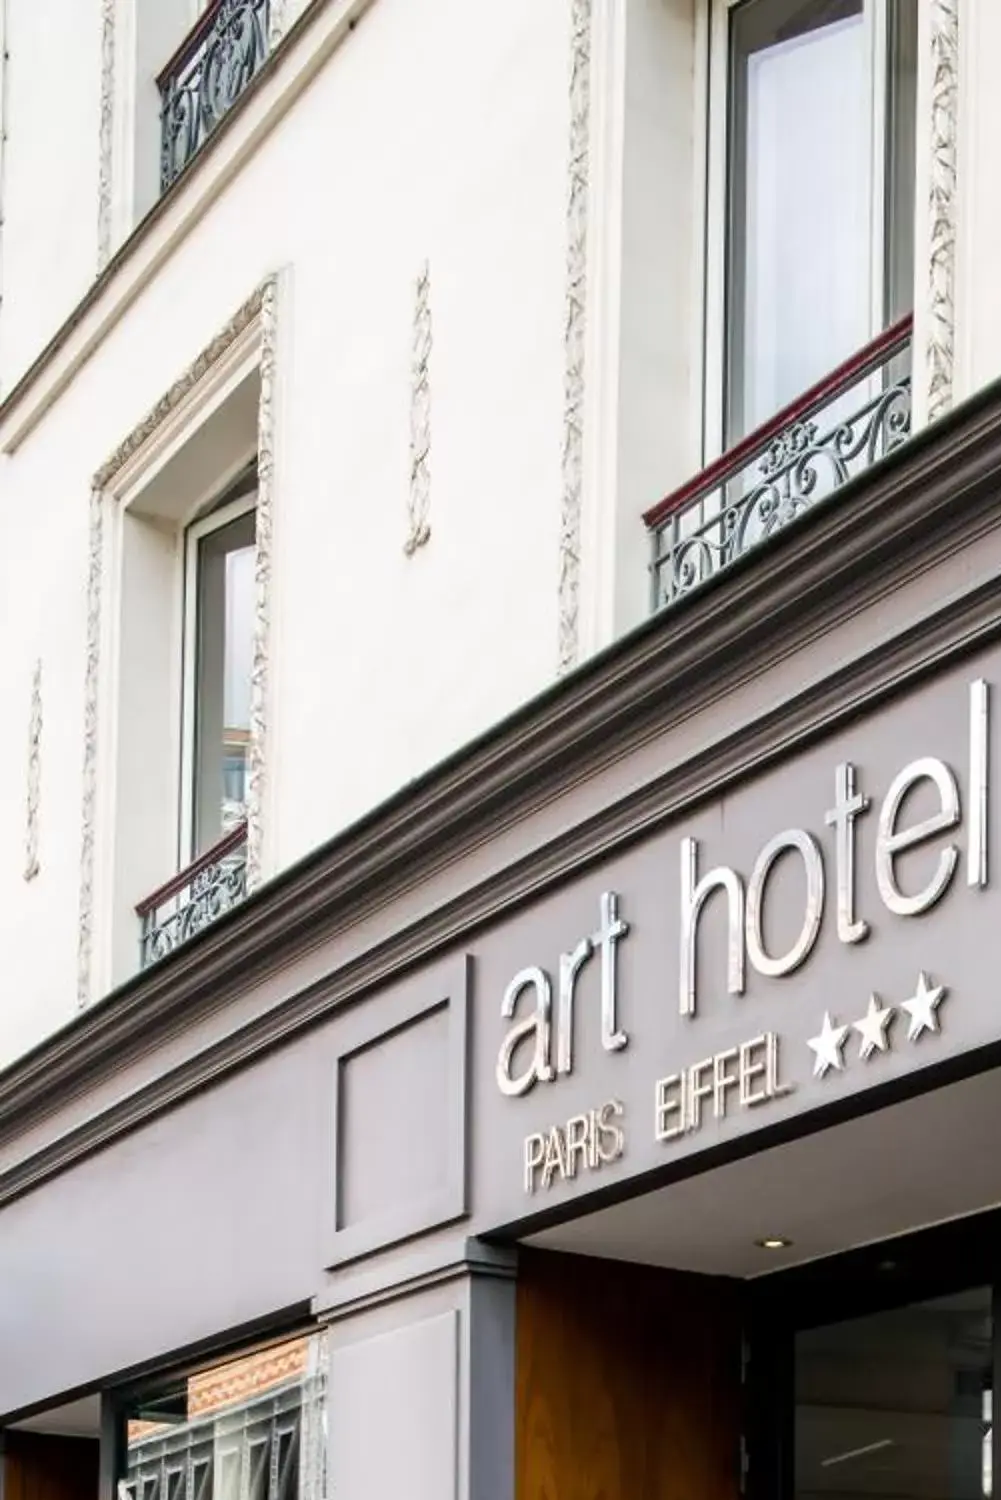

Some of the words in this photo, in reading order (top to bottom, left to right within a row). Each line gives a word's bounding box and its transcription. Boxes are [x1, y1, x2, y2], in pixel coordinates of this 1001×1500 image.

[498, 890, 629, 1096] art
[679, 677, 989, 1018] hotel
[524, 1098, 624, 1194] PARIS
[655, 1030, 797, 1142] EIFFEL
